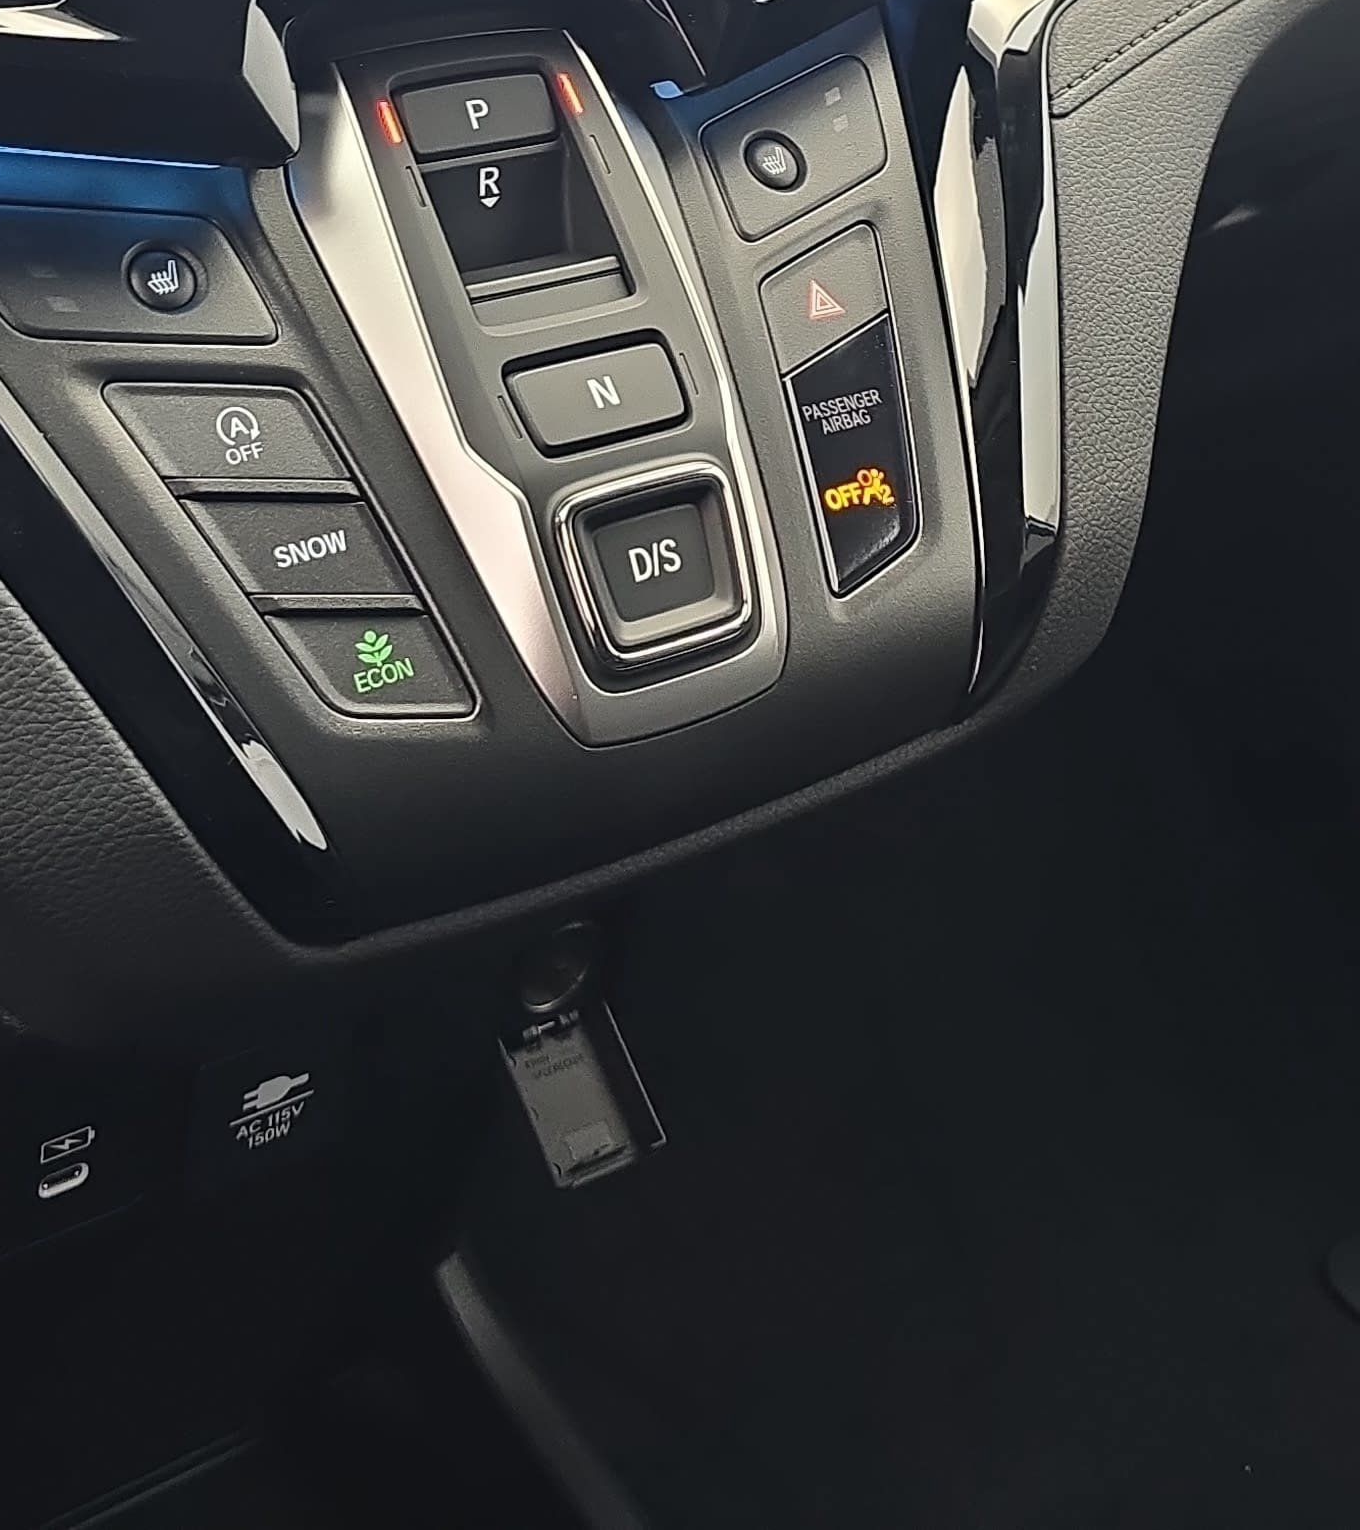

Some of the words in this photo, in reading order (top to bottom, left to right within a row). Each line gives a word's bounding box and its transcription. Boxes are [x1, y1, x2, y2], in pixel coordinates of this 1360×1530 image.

[463, 98, 490, 132] P
[477, 165, 501, 198] R
[586, 375, 622, 409] N
[801, 388, 883, 421] PASSENGER
[820, 408, 871, 435] AIRBAG
[225, 441, 264, 466] OFF
[823, 481, 862, 511] OFF
[273, 530, 348, 569] SNOW
[627, 537, 683, 584] D/S
[353, 657, 415, 695] ECON
[235, 1118, 263, 1141] AC
[267, 1101, 306, 1129] 115V
[246, 1120, 292, 1150] 150W
